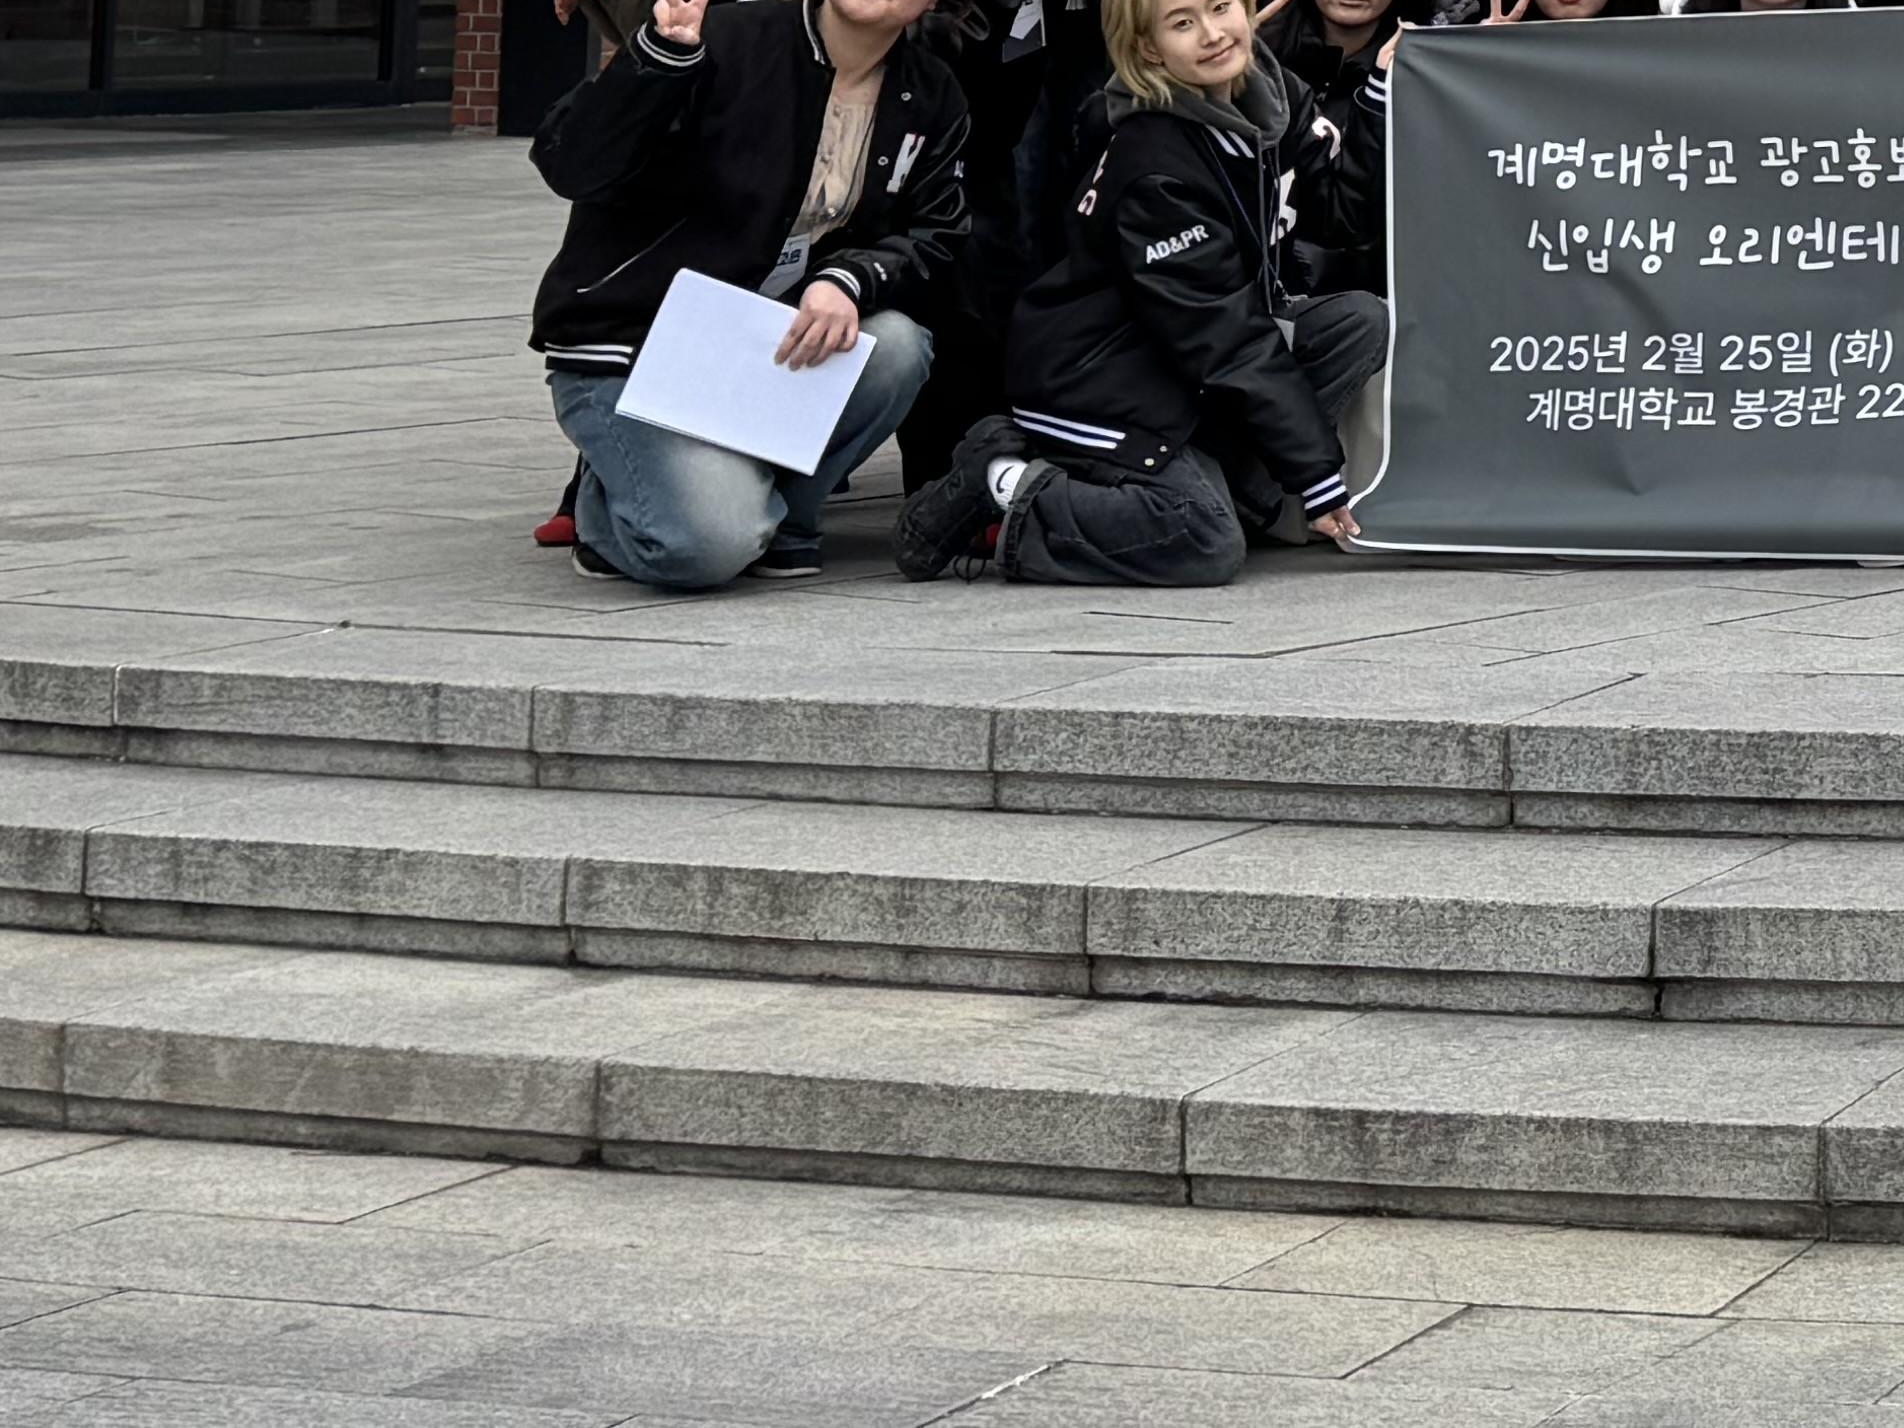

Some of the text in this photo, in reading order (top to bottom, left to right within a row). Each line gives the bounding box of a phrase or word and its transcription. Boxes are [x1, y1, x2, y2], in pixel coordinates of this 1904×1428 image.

[1487, 129, 1738, 192] 계명대학교
[1145, 224, 1210, 265] AD&PR
[1527, 217, 1676, 274] 신입생
[1488, 330, 1630, 373] 2025년
[1641, 330, 1704, 374] 2월
[1719, 330, 1814, 373] 25일
[1828, 328, 1893, 376] (화)
[1525, 387, 1718, 432] 계명대학교
[1730, 382, 1846, 430] 봉경관
